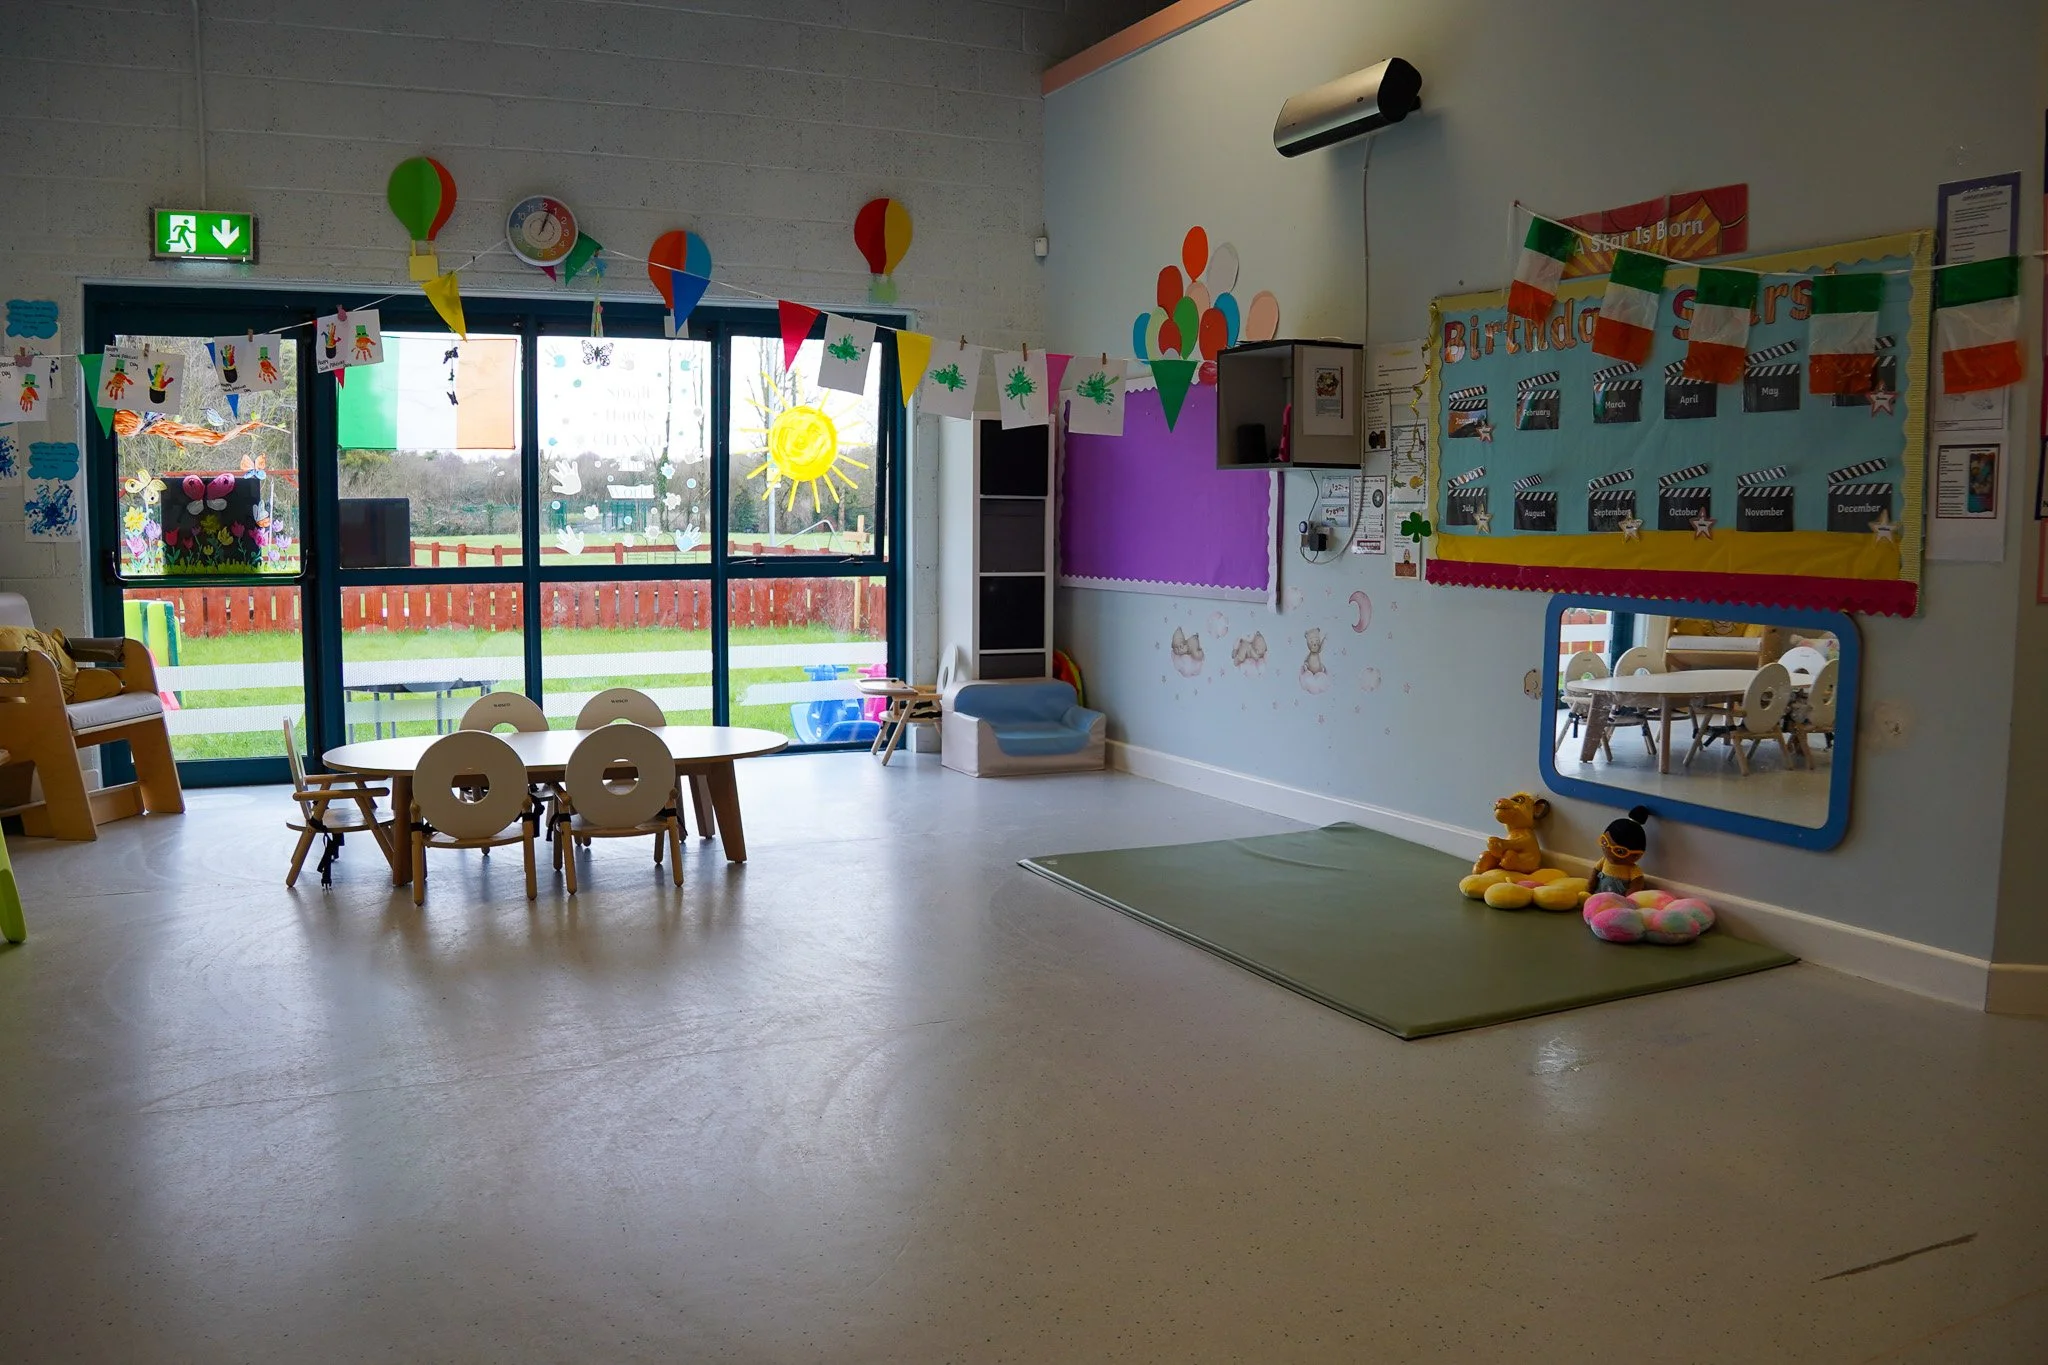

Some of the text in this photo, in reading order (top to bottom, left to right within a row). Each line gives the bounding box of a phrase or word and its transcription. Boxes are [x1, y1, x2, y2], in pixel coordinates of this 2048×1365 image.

[560, 216, 567, 225] 2
[563, 229, 570, 237] 3
[1573, 218, 1705, 256] A Star Is Born
[559, 240, 566, 248] 4
[1444, 279, 1813, 364] Birthda Srs
[1761, 386, 1779, 397] May
[1604, 400, 1626, 409] March
[1679, 394, 1699, 405] April
[1523, 408, 1551, 418] February
[1455, 416, 1479, 426] January
[1461, 504, 1474, 514] July
[1524, 509, 1546, 519] August
[1593, 508, 1631, 518] September
[1669, 507, 1699, 517] October
[1744, 507, 1785, 517] November
[1837, 504, 1881, 514] December
